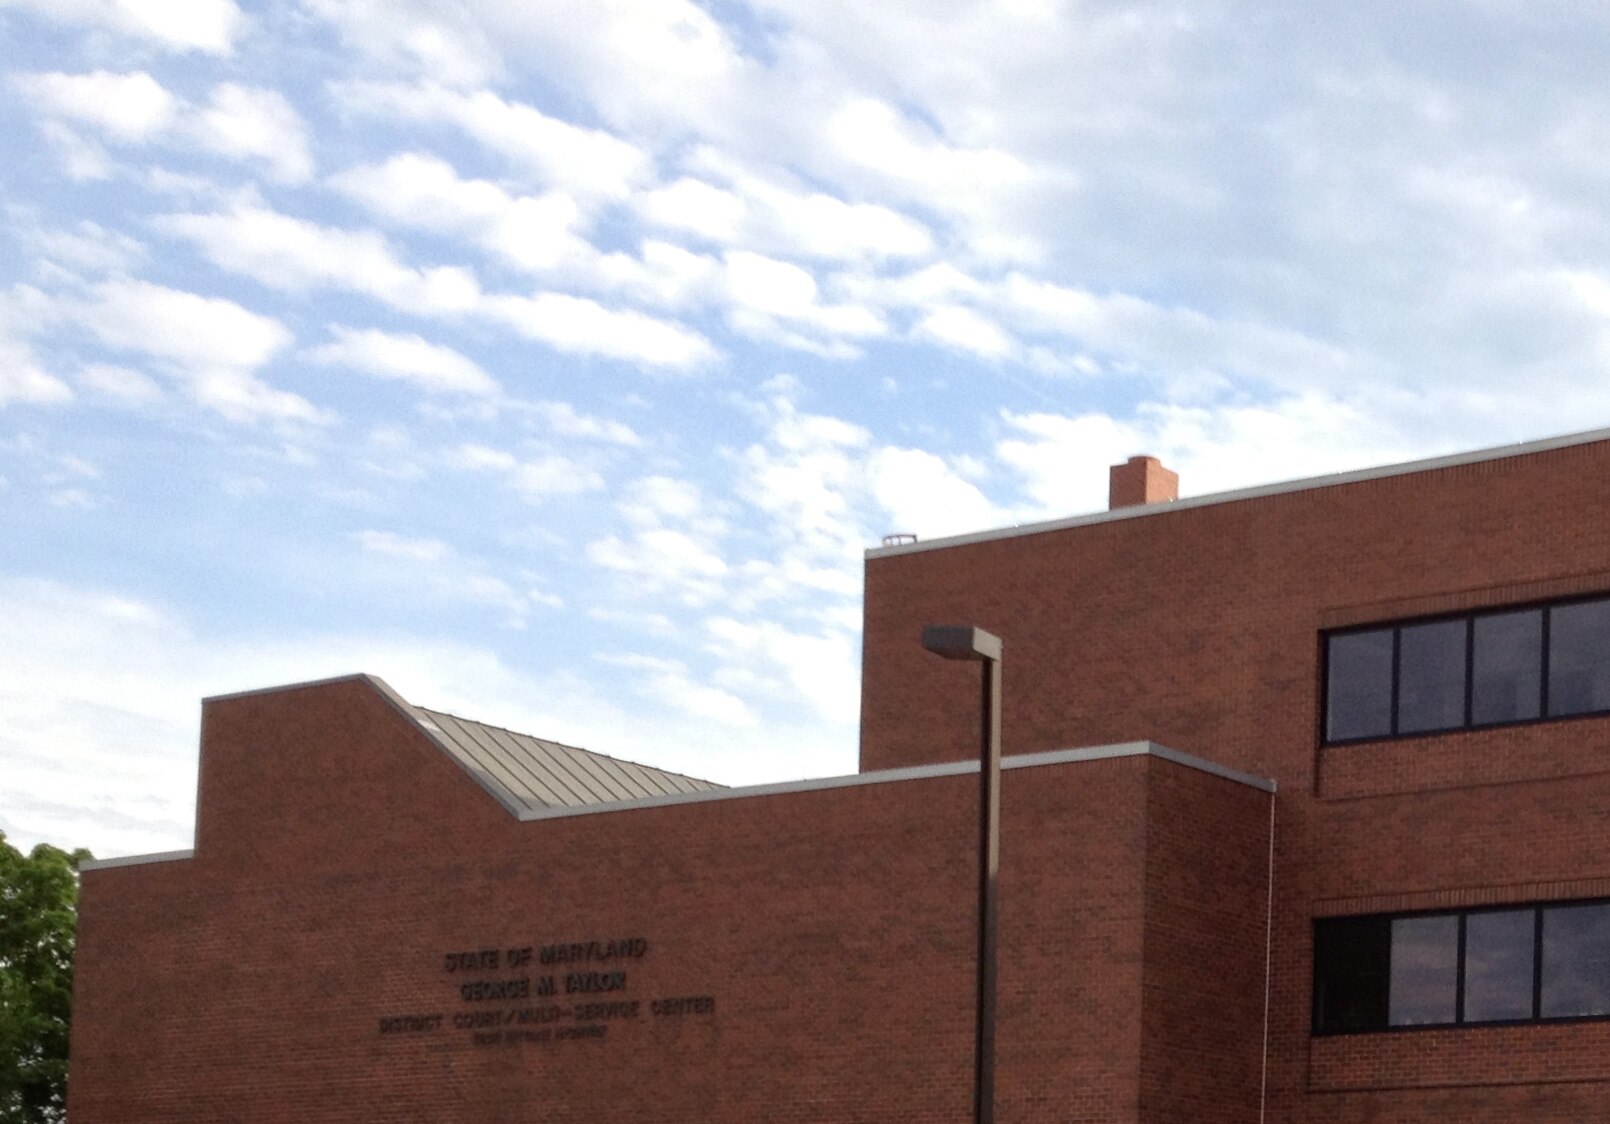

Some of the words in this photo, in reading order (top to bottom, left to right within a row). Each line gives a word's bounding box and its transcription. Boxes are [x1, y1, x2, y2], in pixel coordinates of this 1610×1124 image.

[445, 951, 499, 972] STATE
[507, 947, 532, 967] OF
[541, 939, 647, 965] MARYLAND
